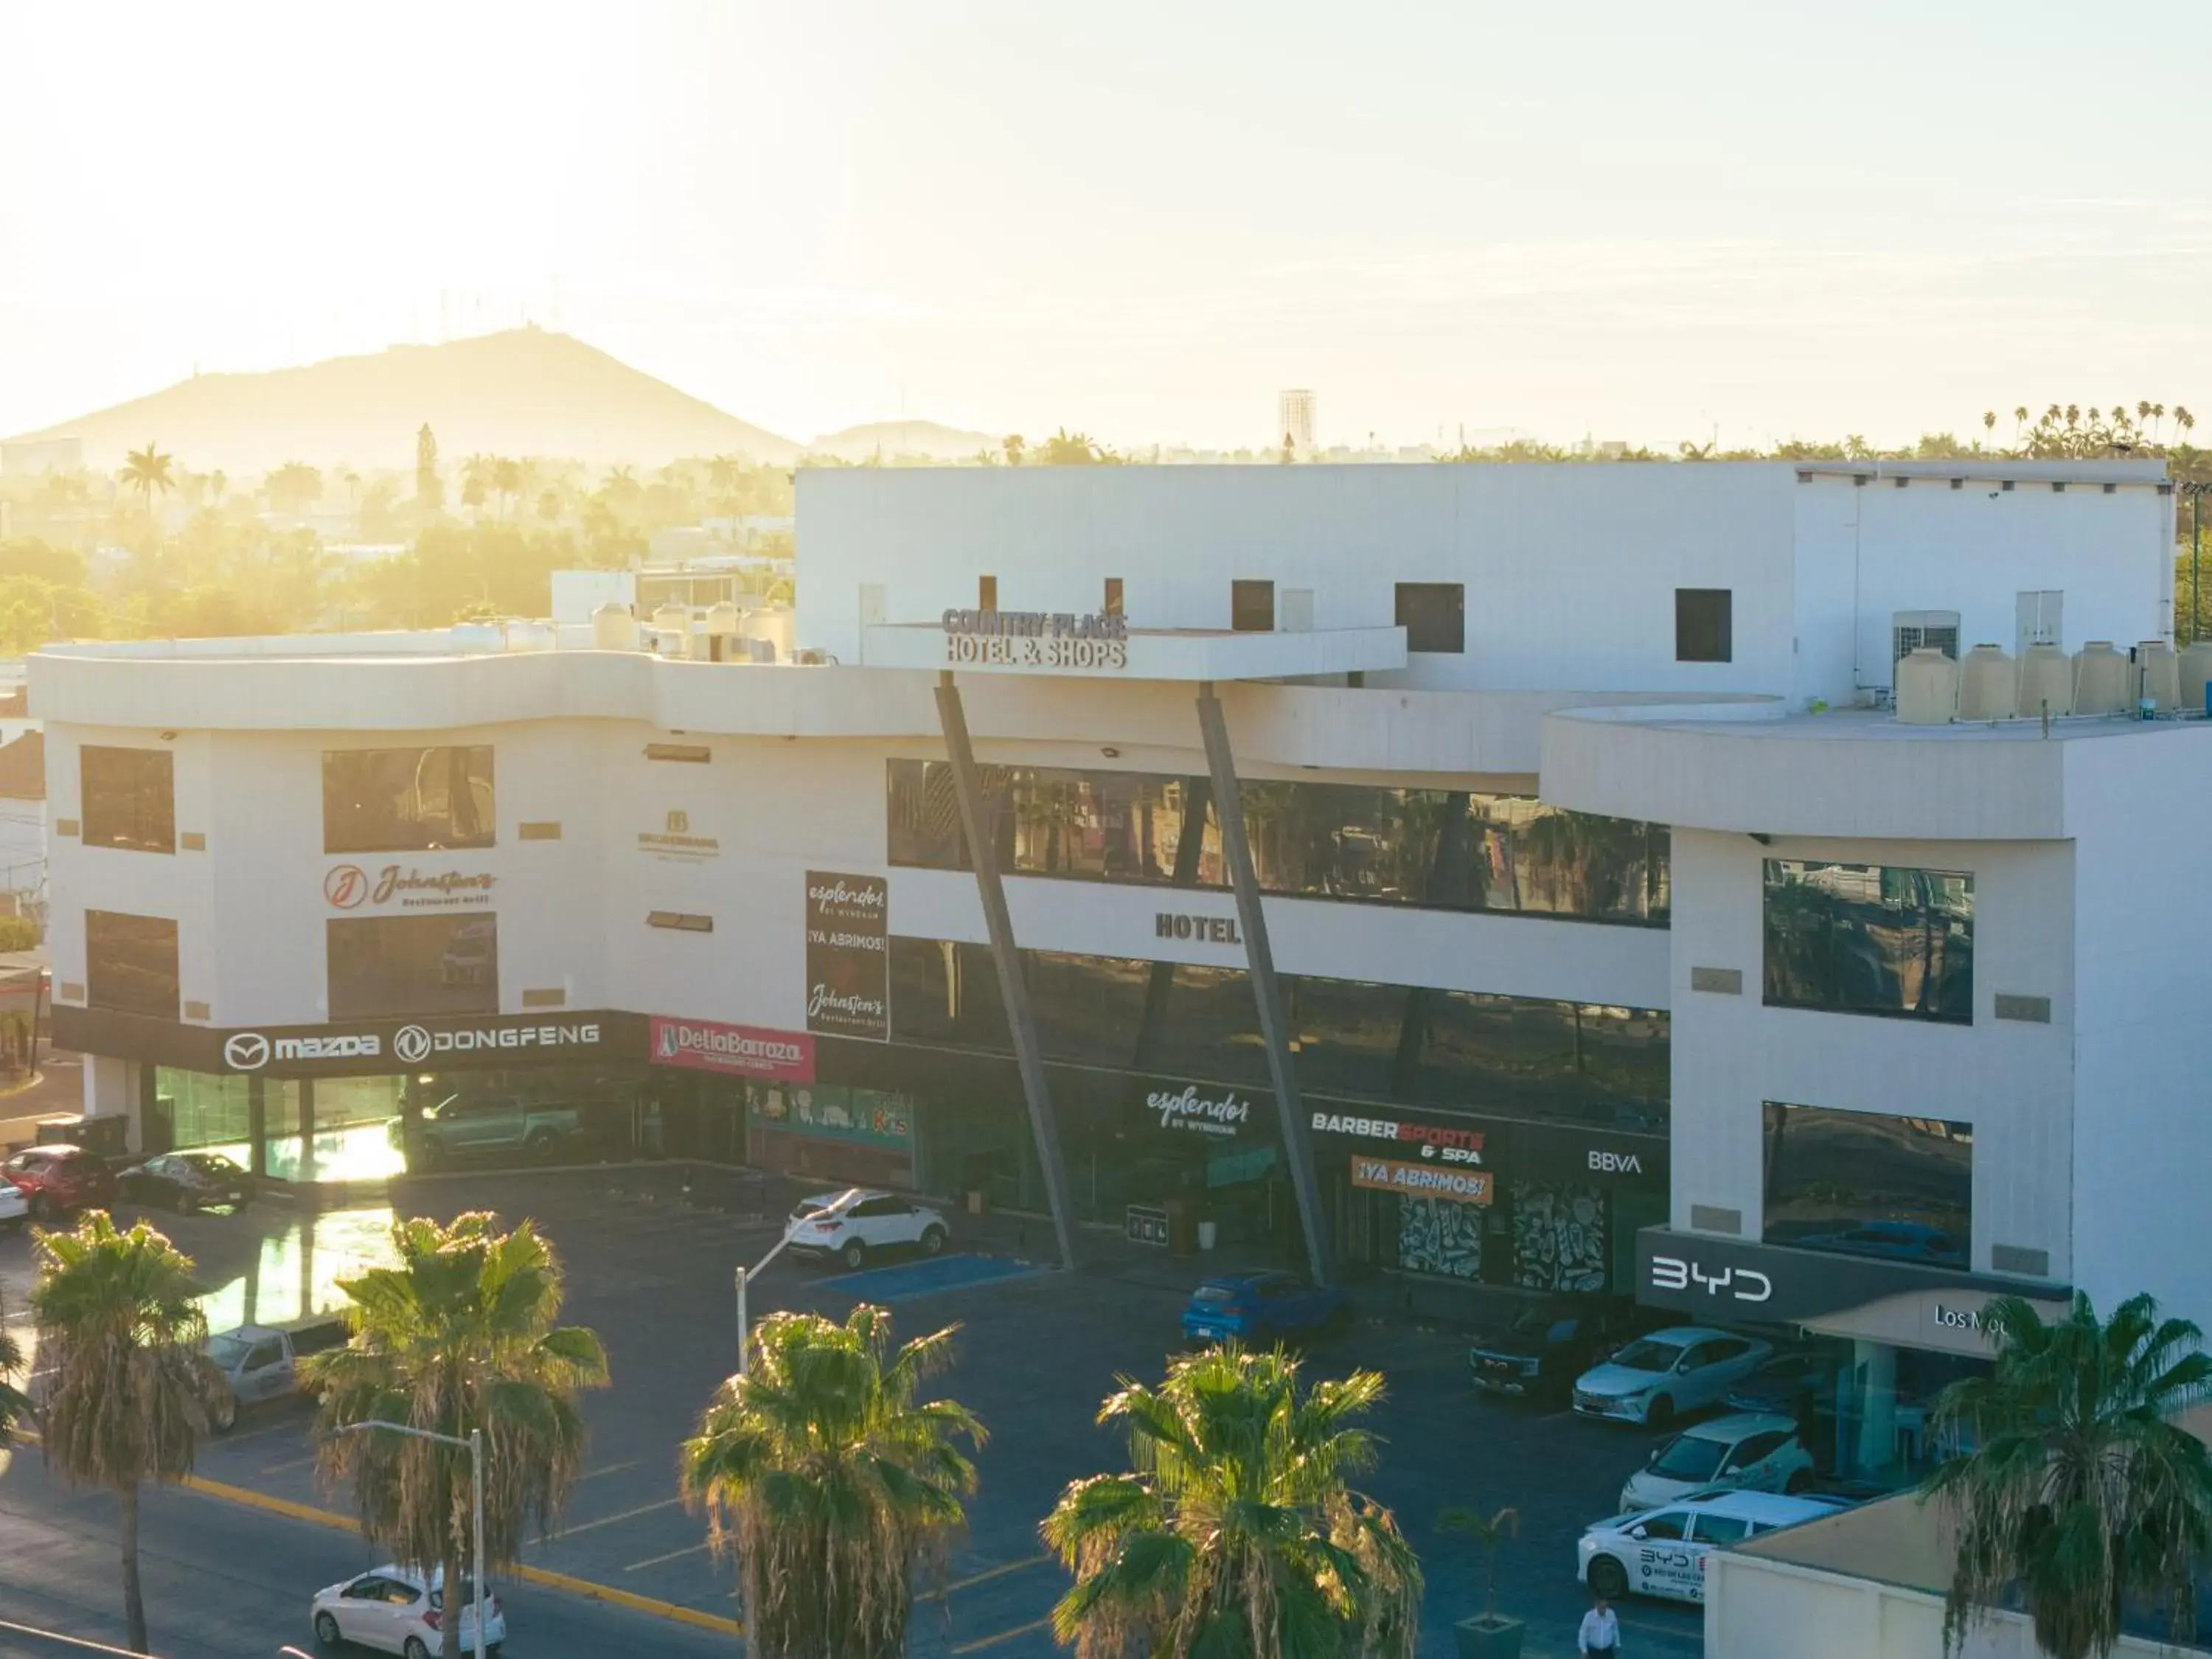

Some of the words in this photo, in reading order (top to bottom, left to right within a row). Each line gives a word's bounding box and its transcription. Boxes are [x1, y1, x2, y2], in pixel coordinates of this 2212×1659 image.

[942, 609, 1047, 638] COUNTRY
[1052, 611, 1128, 641] PLACE
[947, 636, 1017, 664] HOTEL
[1024, 639, 1041, 666] &
[1048, 639, 1127, 669] SHOPS
[830, 931, 885, 951] ABRIMOS!
[1155, 913, 1242, 945] HOTEL
[434, 1024, 600, 1051] DONGFENG
[1441, 1147, 1481, 1165] SPA
[1588, 1150, 1643, 1174] BBVA
[1394, 1168, 1485, 1195] ABRIMOS!
[1652, 1256, 1772, 1301] BYD
[1935, 1304, 1966, 1329] Los
[1640, 1549, 1688, 1567] BYD
